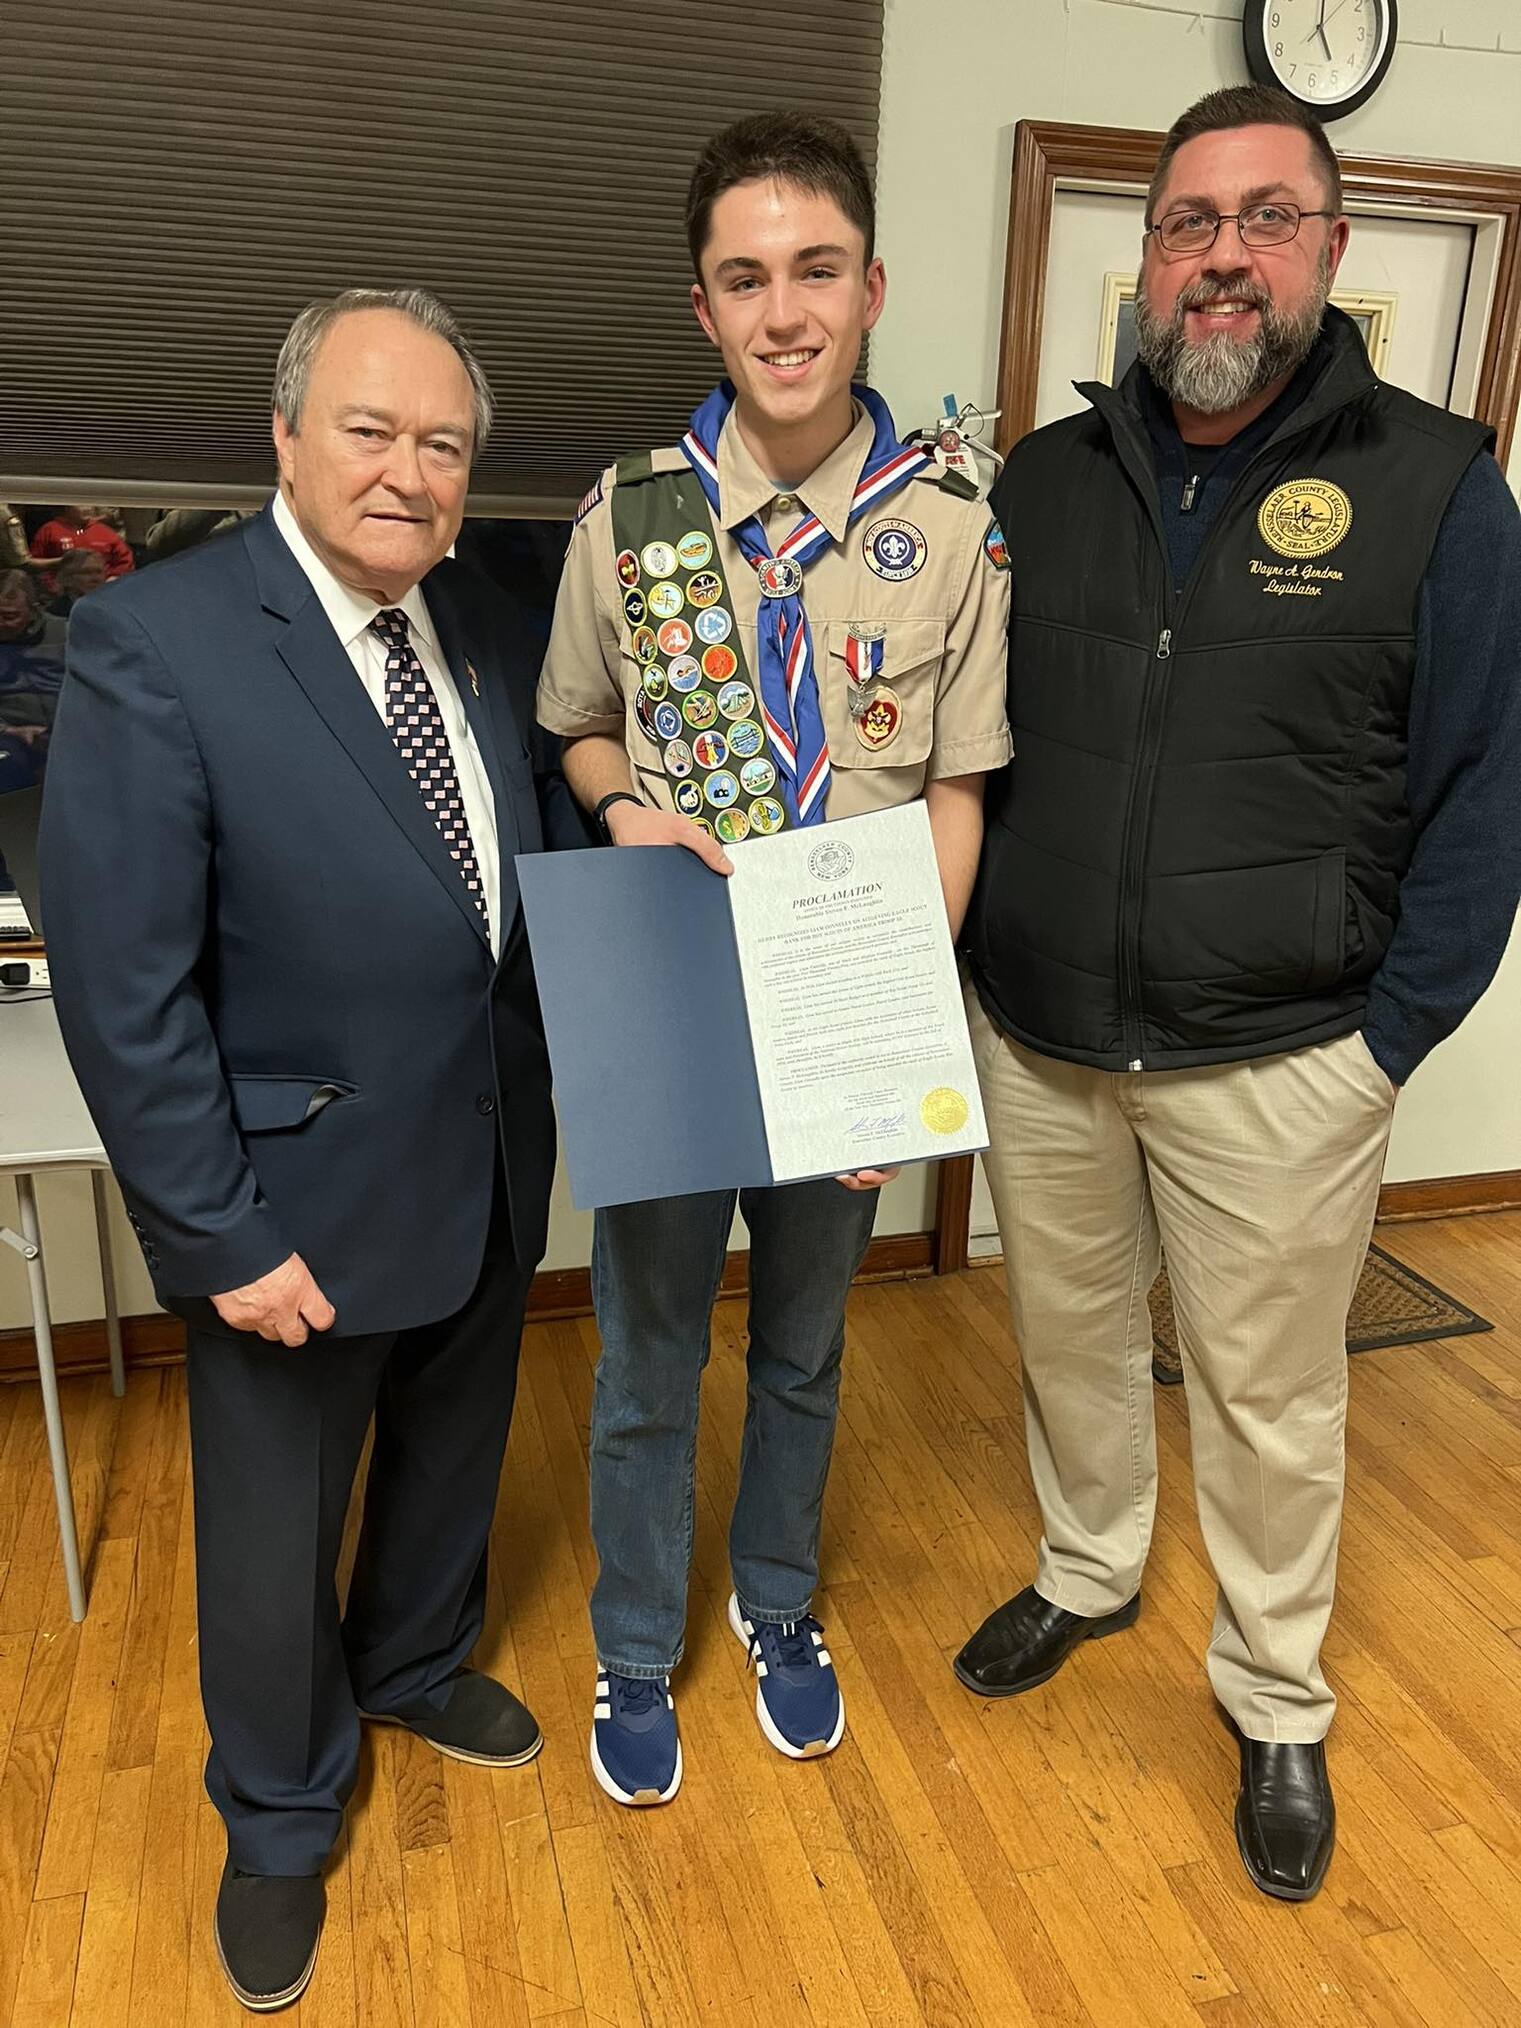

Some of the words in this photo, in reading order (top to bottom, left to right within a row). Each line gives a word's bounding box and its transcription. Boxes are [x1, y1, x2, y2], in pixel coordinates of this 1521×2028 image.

[1354, 0, 1362, 13] 2
[1271, 12, 1280, 29] 9
[1357, 26, 1365, 42] 3
[1274, 42, 1284, 58] 8
[1347, 53, 1355, 67] 4
[1289, 63, 1297, 79] 7
[1330, 70, 1338, 84] 5
[1308, 73, 1317, 88] 6
[1265, 493, 1287, 543] RENSSELAER
[1288, 485, 1330, 496] COUNTY
[1312, 493, 1344, 546] LEGISLATURE
[1286, 540, 1311, 550] SEAL
[1248, 559, 1284, 577] Wayne
[1300, 564, 1345, 581] Gendron
[1262, 578, 1322, 597] Legislator
[792, 882, 883, 909] PROCLAMATION
